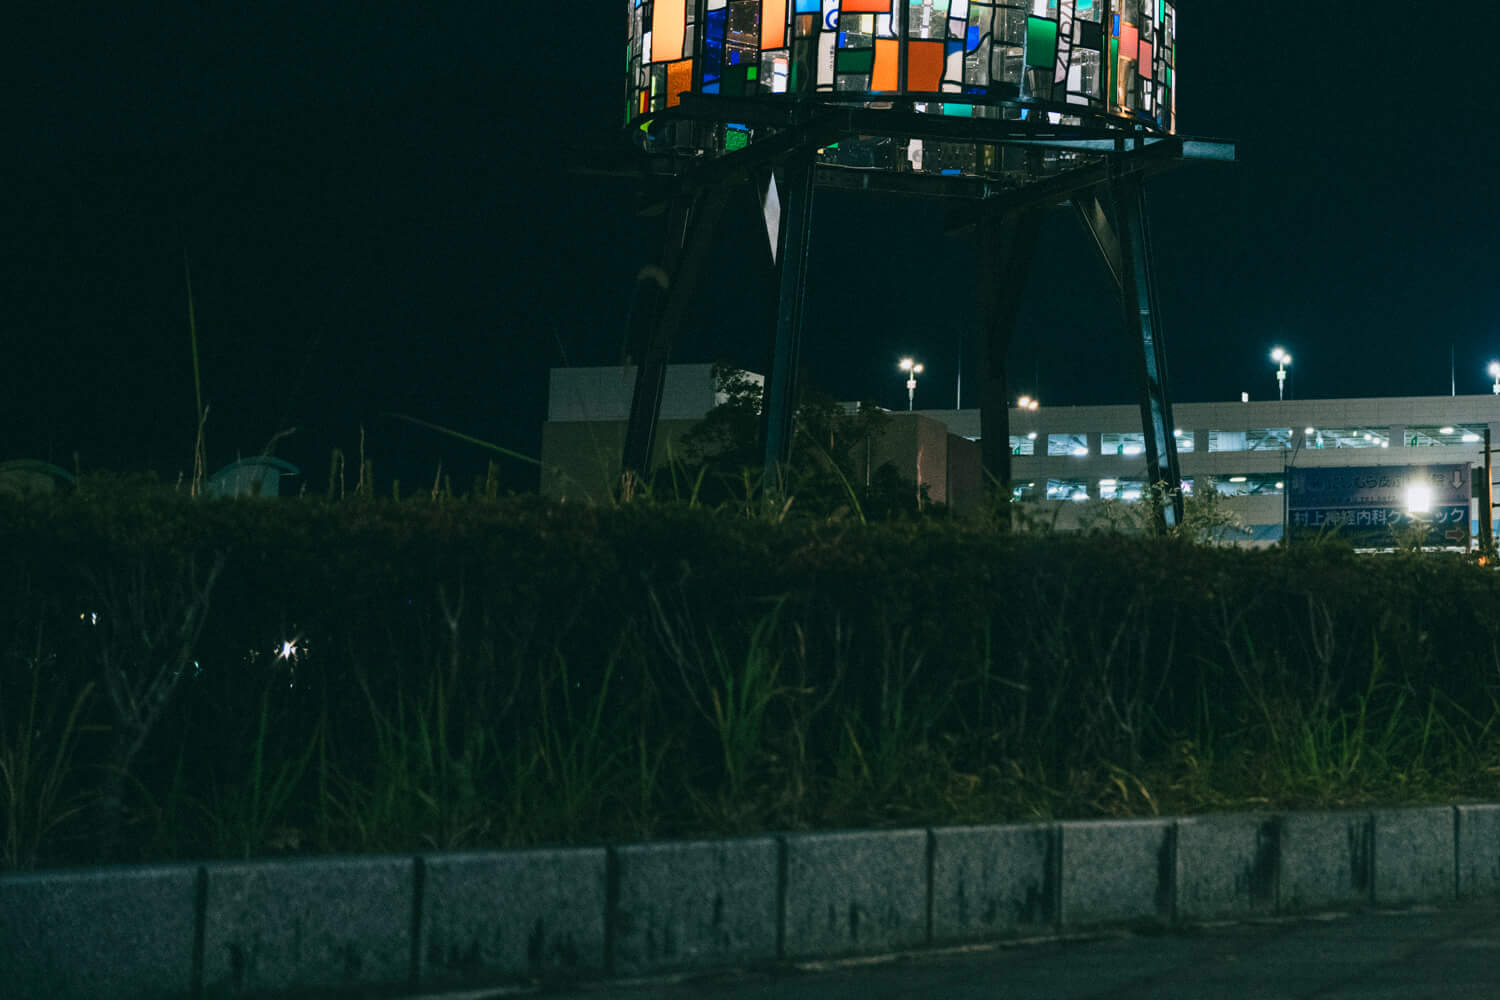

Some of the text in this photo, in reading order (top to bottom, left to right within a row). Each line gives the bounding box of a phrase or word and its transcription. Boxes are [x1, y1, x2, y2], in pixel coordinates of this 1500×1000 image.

[1293, 507, 1465, 527] 村上神経内科クック
